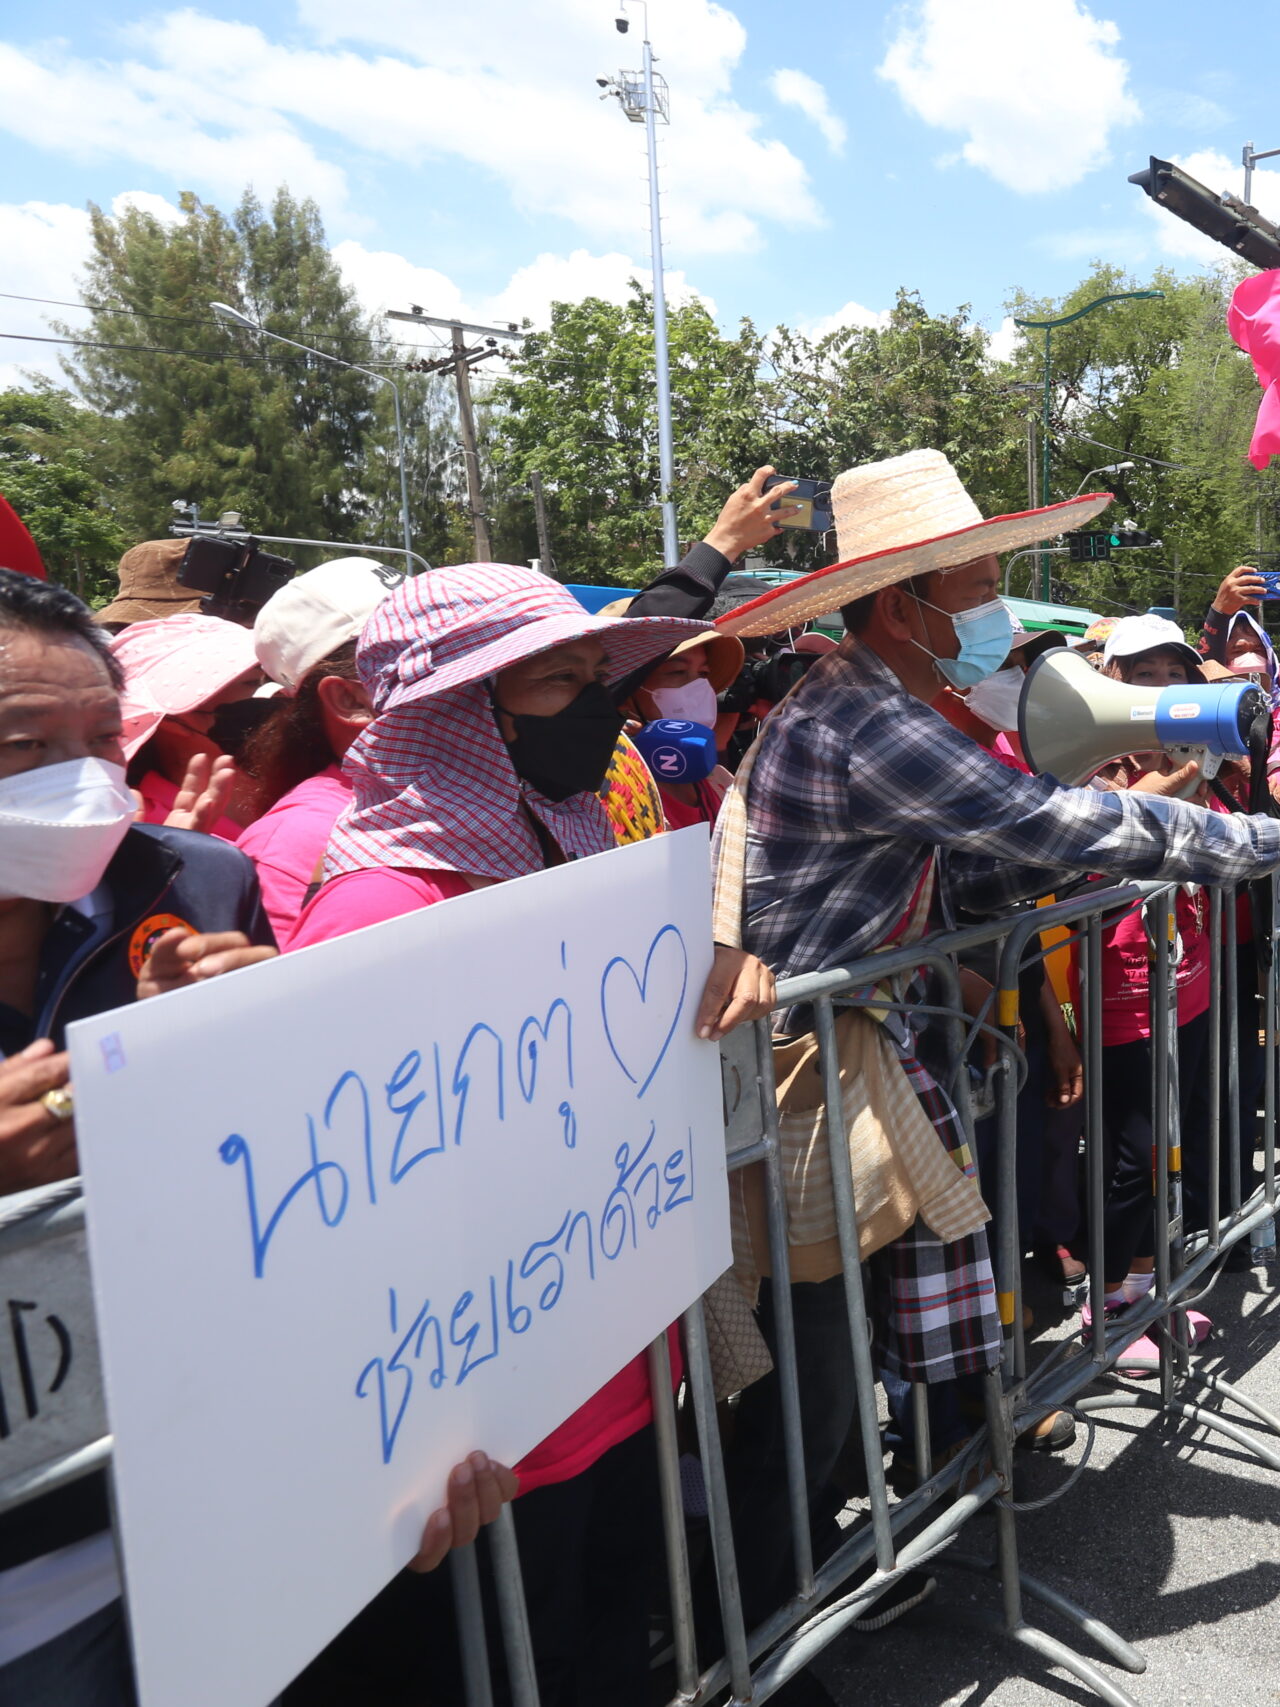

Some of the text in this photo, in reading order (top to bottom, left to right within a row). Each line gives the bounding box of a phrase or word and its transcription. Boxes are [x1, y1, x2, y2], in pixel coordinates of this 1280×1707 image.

[218, 940, 578, 1280] นายกตู่
[355, 1119, 695, 1465] ช่วยเราด้วย
